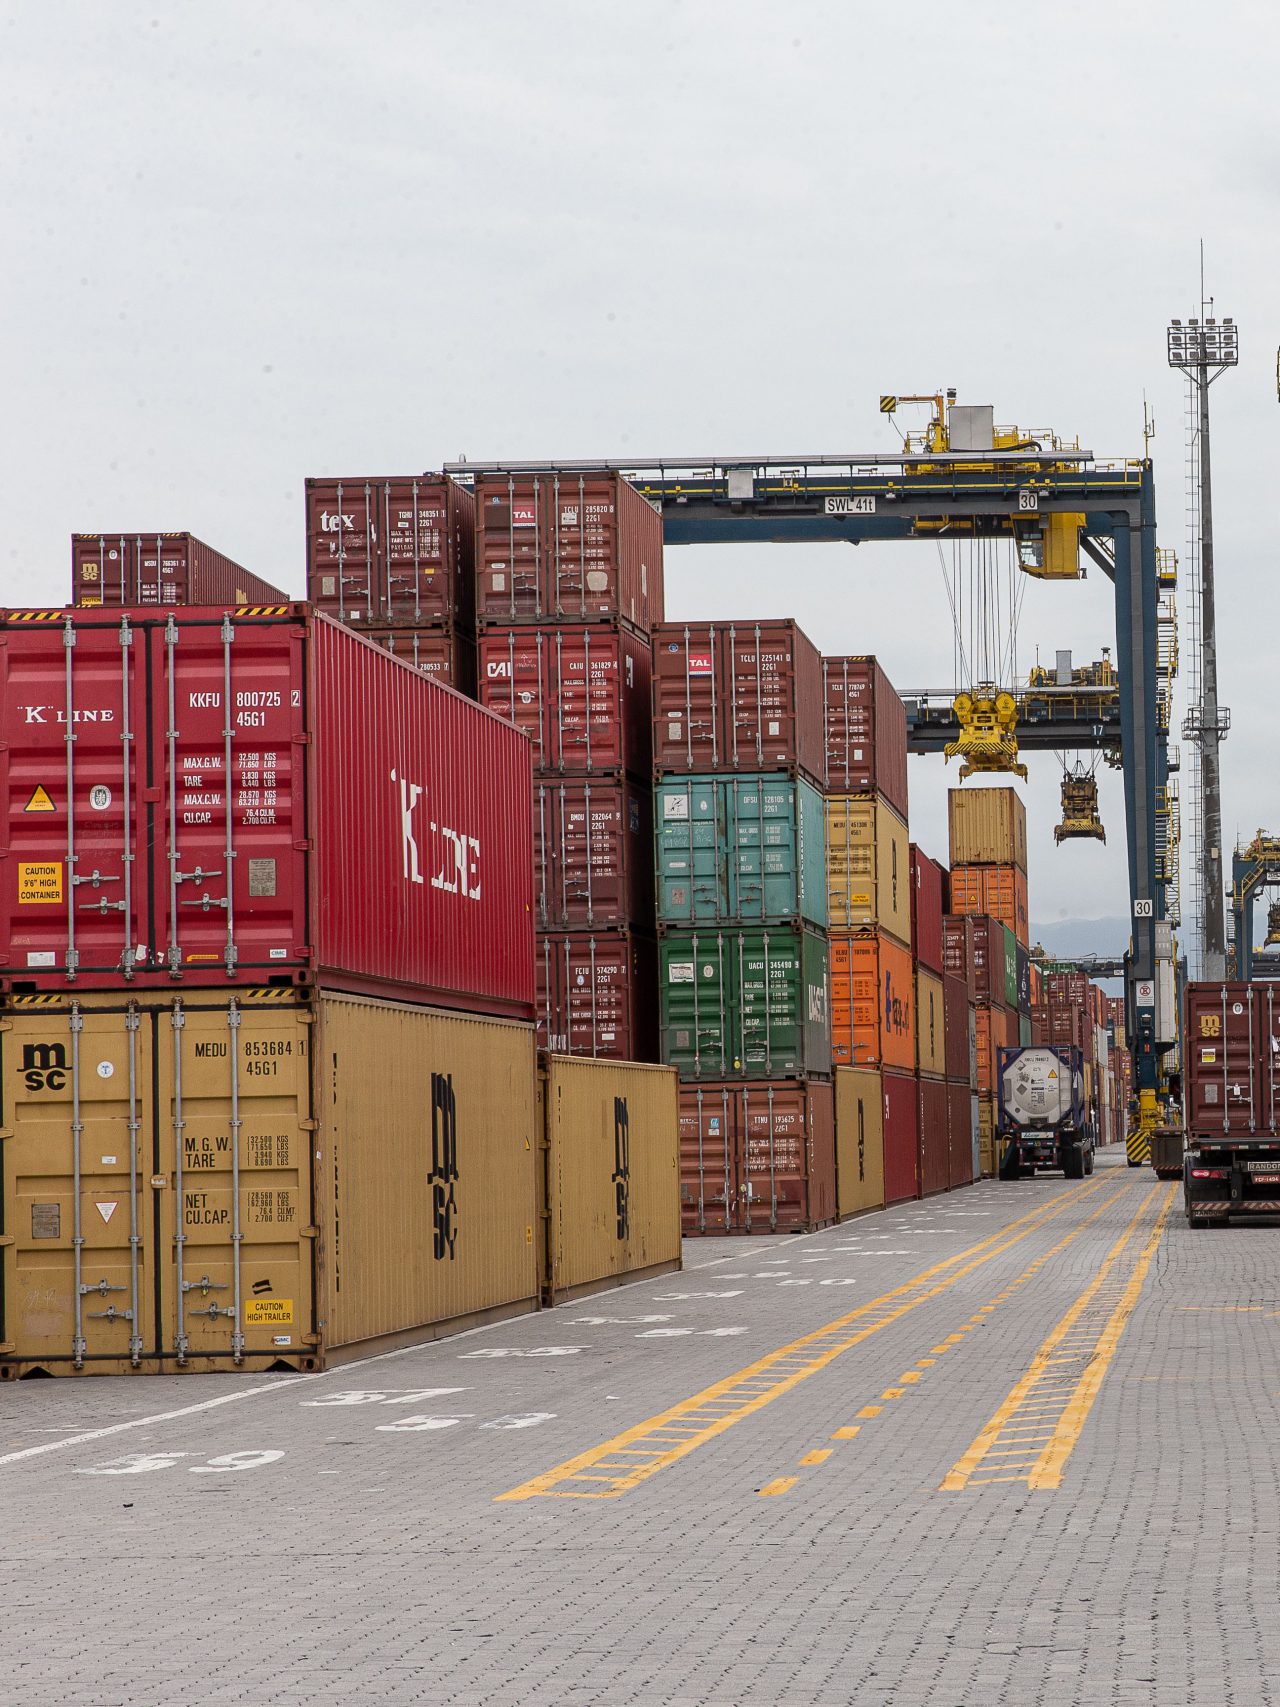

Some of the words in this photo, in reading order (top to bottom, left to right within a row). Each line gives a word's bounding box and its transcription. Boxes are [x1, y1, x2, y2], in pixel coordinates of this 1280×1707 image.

[828, 500, 852, 512] SWL
[856, 500, 873, 512] 41t
[1020, 500, 1036, 510] 30
[419, 510, 439, 518] 348351
[320, 510, 356, 532] tex
[487, 662, 512, 677] CAI
[189, 693, 220, 708] KKFU
[237, 692, 281, 707] 800725
[56, 710, 114, 723] LINE
[237, 712, 265, 726] 45G1
[183, 758, 222, 768] MAX.G.W.
[183, 776, 202, 786] TARE
[184, 794, 221, 805] MAX.C.W.
[184, 812, 212, 823] CU.CAP.
[25, 866, 56, 875] CAUTION
[39, 879, 56, 887] HIGH
[21, 890, 60, 900] CONTAINER
[1136, 902, 1150, 915] 30
[749, 962, 764, 970] UACU
[195, 1043, 227, 1057] MEDU
[245, 1041, 292, 1056] 853684
[246, 1061, 277, 1076] 45G1
[186, 1153, 216, 1168] TARE
[276, 1158, 289, 1166] LBS
[186, 1194, 207, 1209] NET
[277, 1192, 290, 1200] KGS
[186, 1210, 230, 1225] CU.CAP.
[256, 1303, 284, 1311] CAUTION
[264, 1312, 291, 1321] TRAILER
[299, 1386, 476, 1407] 57
[71, 1449, 286, 1475] 59
